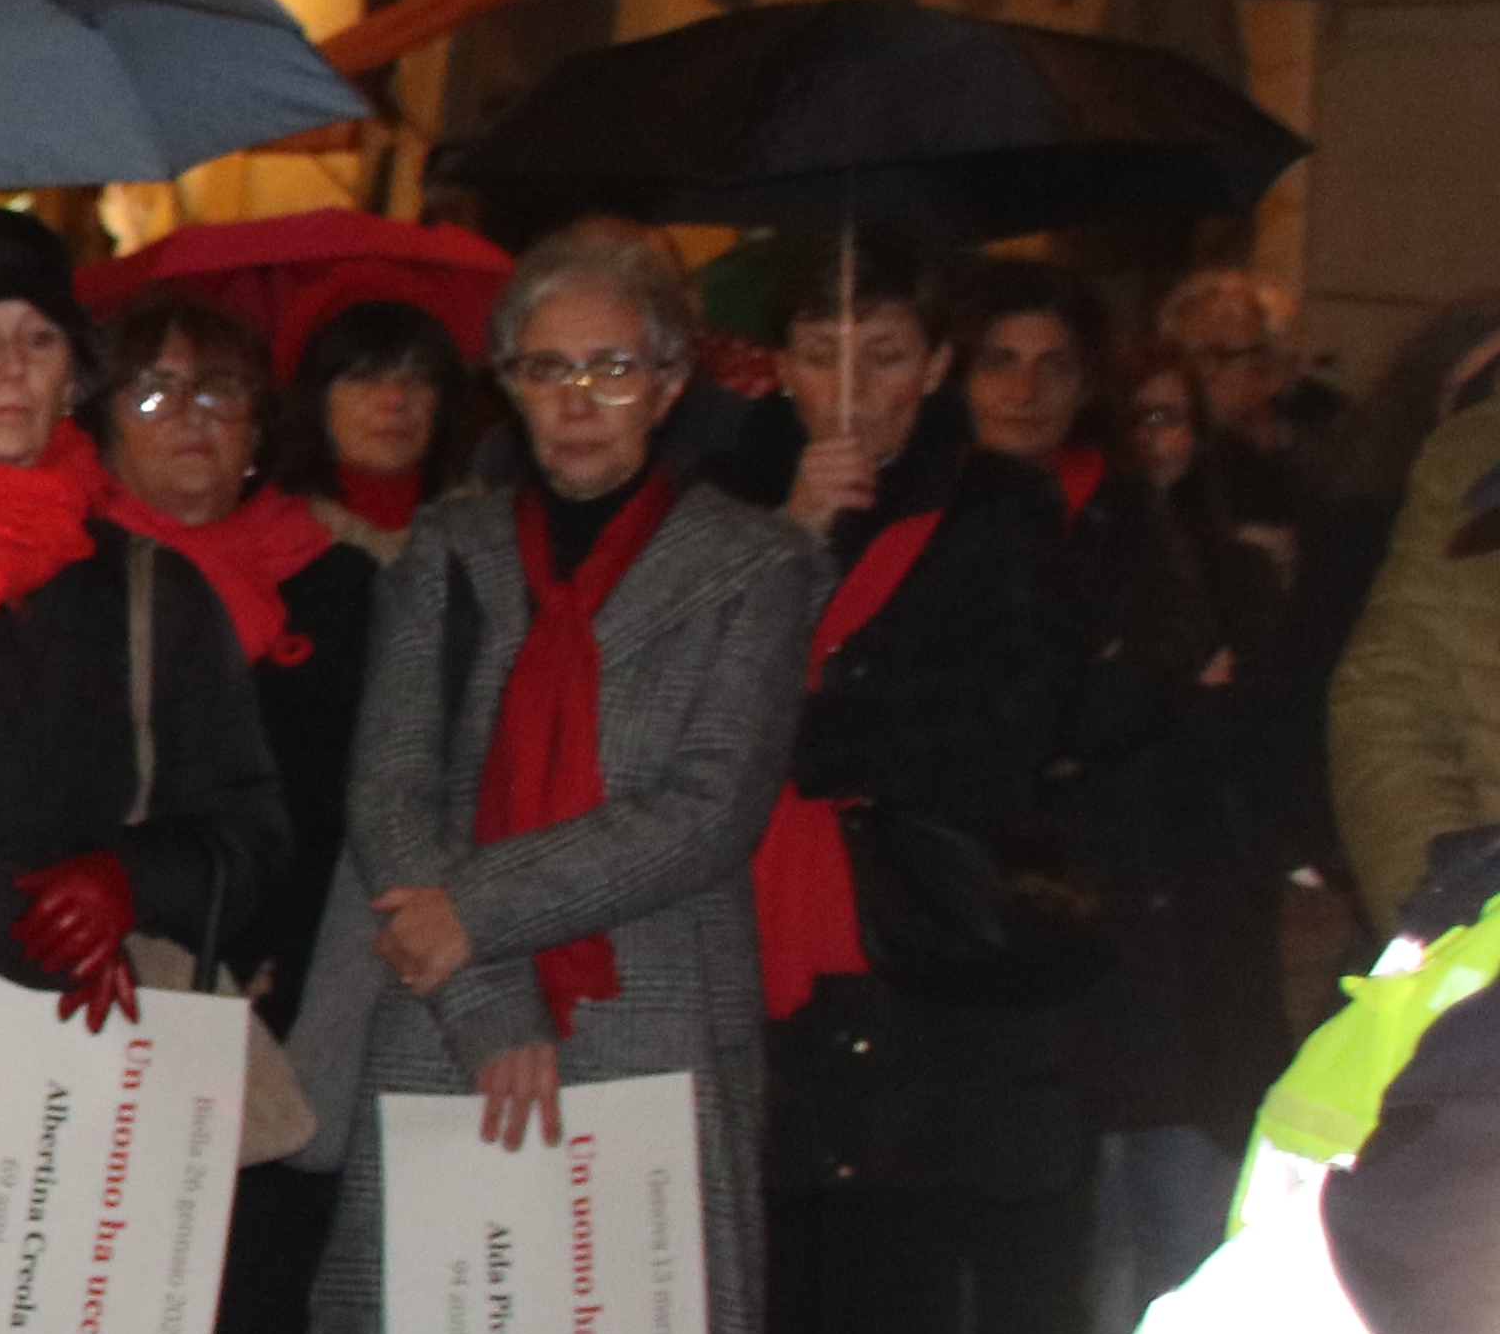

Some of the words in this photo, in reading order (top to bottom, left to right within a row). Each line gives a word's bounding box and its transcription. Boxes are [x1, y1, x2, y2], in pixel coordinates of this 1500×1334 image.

[121, 1037, 155, 1090] Un
[27, 1078, 70, 1223] Albertina
[103, 1101, 137, 1209] uomo
[569, 1133, 595, 1186] Un
[92, 1219, 127, 1264] ha
[572, 1195, 593, 1297] uomo
